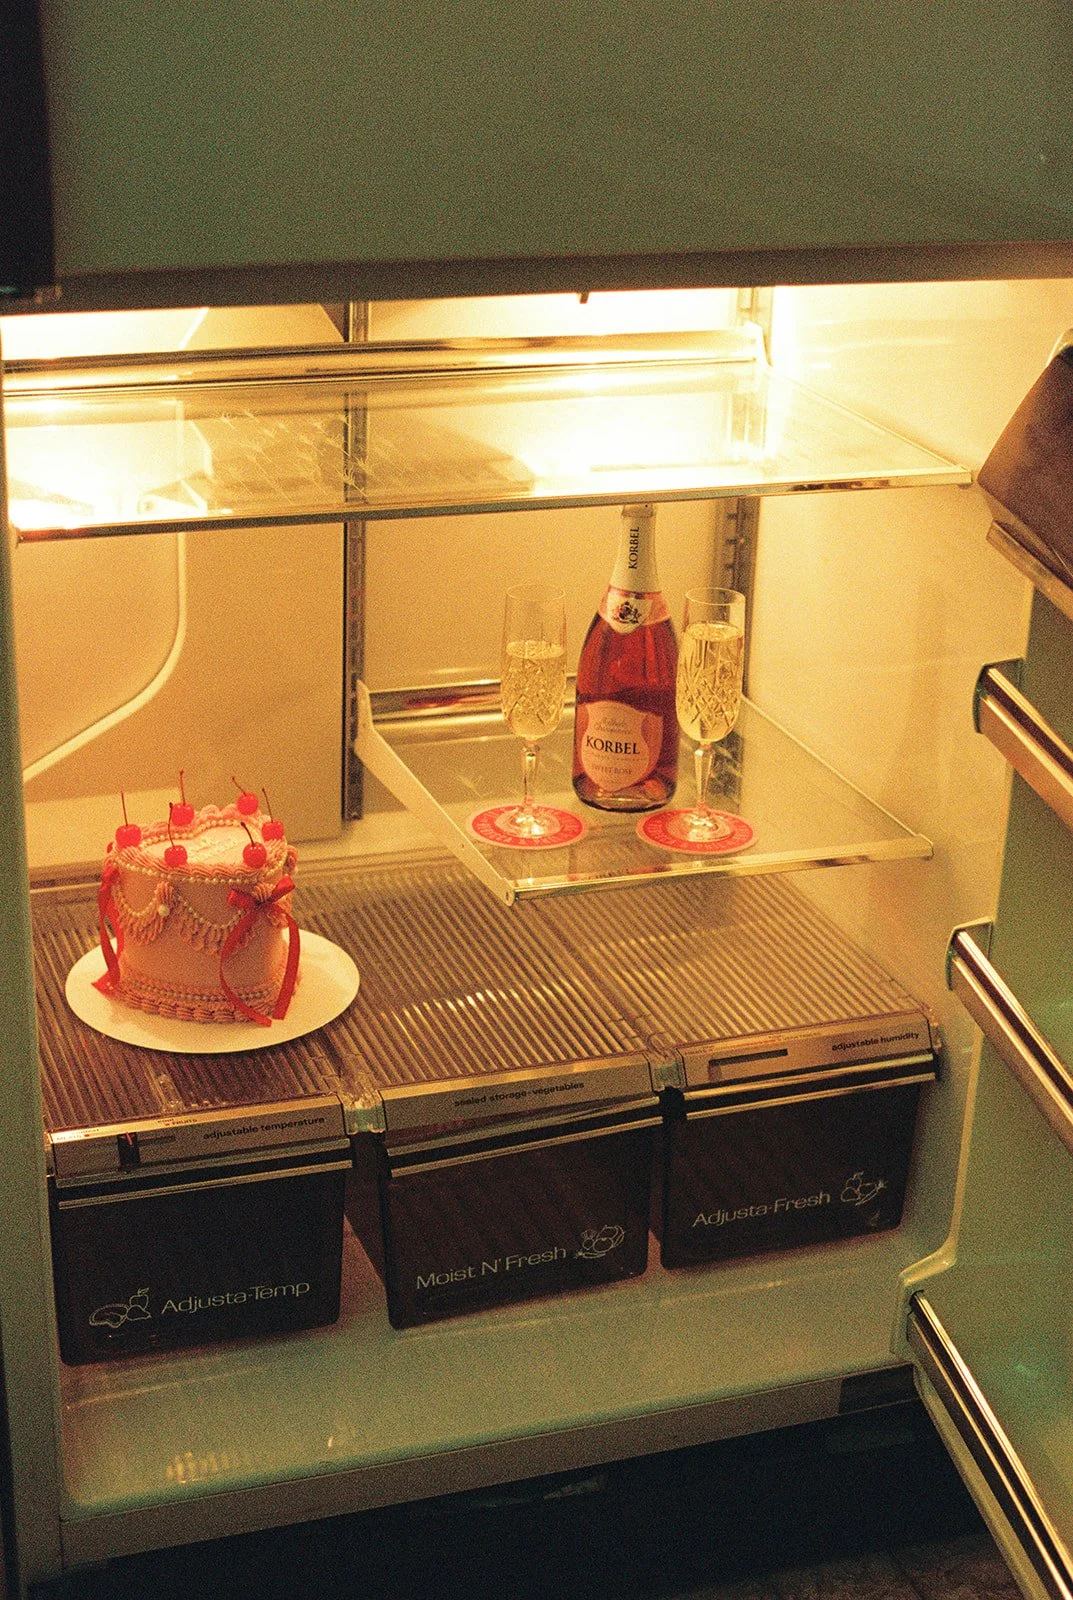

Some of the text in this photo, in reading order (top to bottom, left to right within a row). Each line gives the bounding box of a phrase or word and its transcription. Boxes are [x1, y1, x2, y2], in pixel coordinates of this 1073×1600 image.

[628, 527, 640, 569] KORBEL
[586, 735, 641, 755] KORBEL
[832, 1032, 919, 1051] adjustable humidity
[454, 1096, 487, 1107] sealed
[203, 1116, 325, 1140] adjustable temperature
[692, 1191, 831, 1228] Adjusta-Fresh
[416, 1246, 567, 1290] Moist N' Fresh
[161, 1282, 310, 1314] Adjusta-Temp
